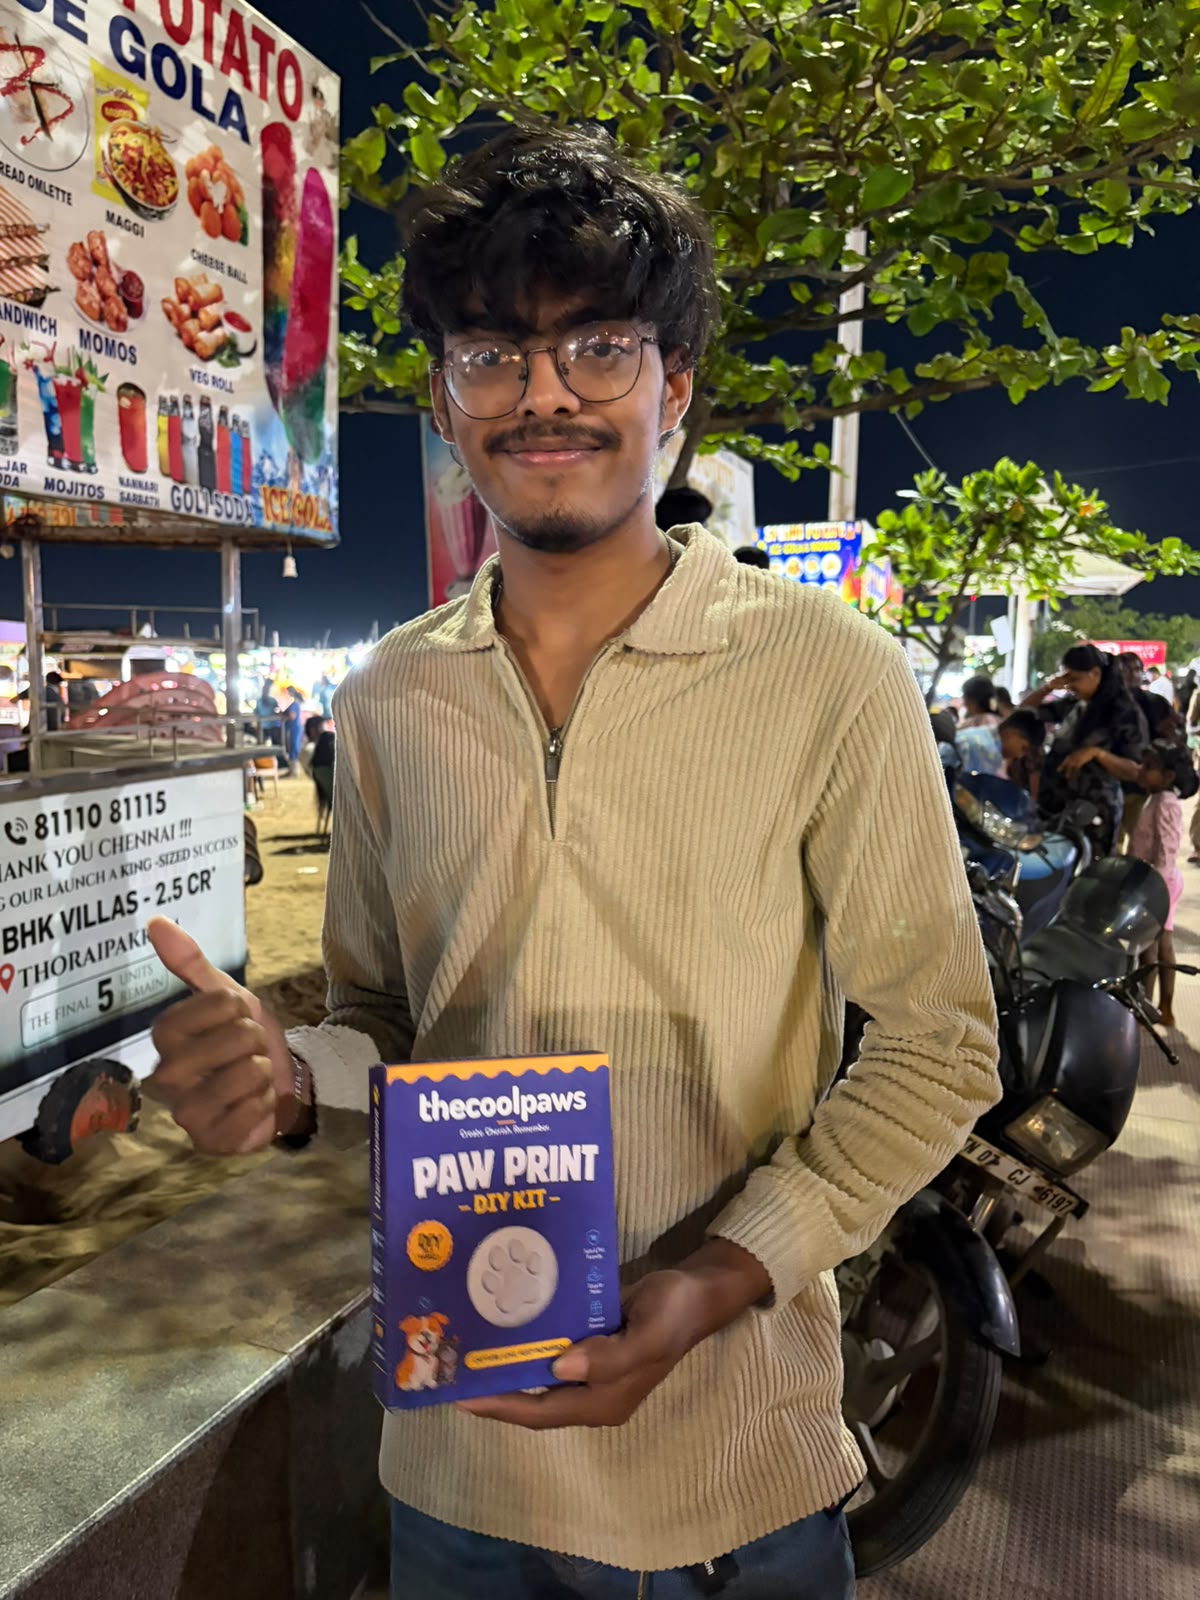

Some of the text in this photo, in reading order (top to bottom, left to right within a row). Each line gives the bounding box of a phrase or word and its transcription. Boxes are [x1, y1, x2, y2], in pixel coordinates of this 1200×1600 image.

[15, 0, 250, 145] E GOLA
[121, 0, 303, 122] OTATO
[28, 174, 72, 207] OMLETTE
[105, 209, 145, 238] MAGGI
[191, 248, 248, 285] CHEESE BALL
[79, 328, 137, 366] MOMOS
[189, 368, 234, 394] VEG ROLL
[44, 477, 105, 500] MOJITOS
[214, 493, 254, 521] SODA
[261, 486, 289, 524] ICE
[35, 790, 167, 840] 81110 81115
[54, 841, 94, 869] YOU
[97, 829, 176, 858] CHENNAI
[9, 887, 43, 907] OUR
[47, 871, 106, 898] LAUNCH
[109, 867, 118, 880] A
[120, 858, 153, 879] KING
[193, 836, 239, 859] SUCCESS
[2, 912, 55, 955] BHK
[60, 889, 139, 936] VILLAS
[156, 876, 183, 907] 2.5
[119, 963, 154, 986] UNITS
[120, 977, 165, 1001] REMAIN
[29, 977, 114, 1032] THE FINAL 5
[418, 1085, 587, 1123] thecoolpaws
[412, 1149, 495, 1200] PAW
[504, 1144, 600, 1186] PRINT
[1007, 1168, 1030, 1186] CJ
[474, 1188, 547, 1215] DIY KIT
